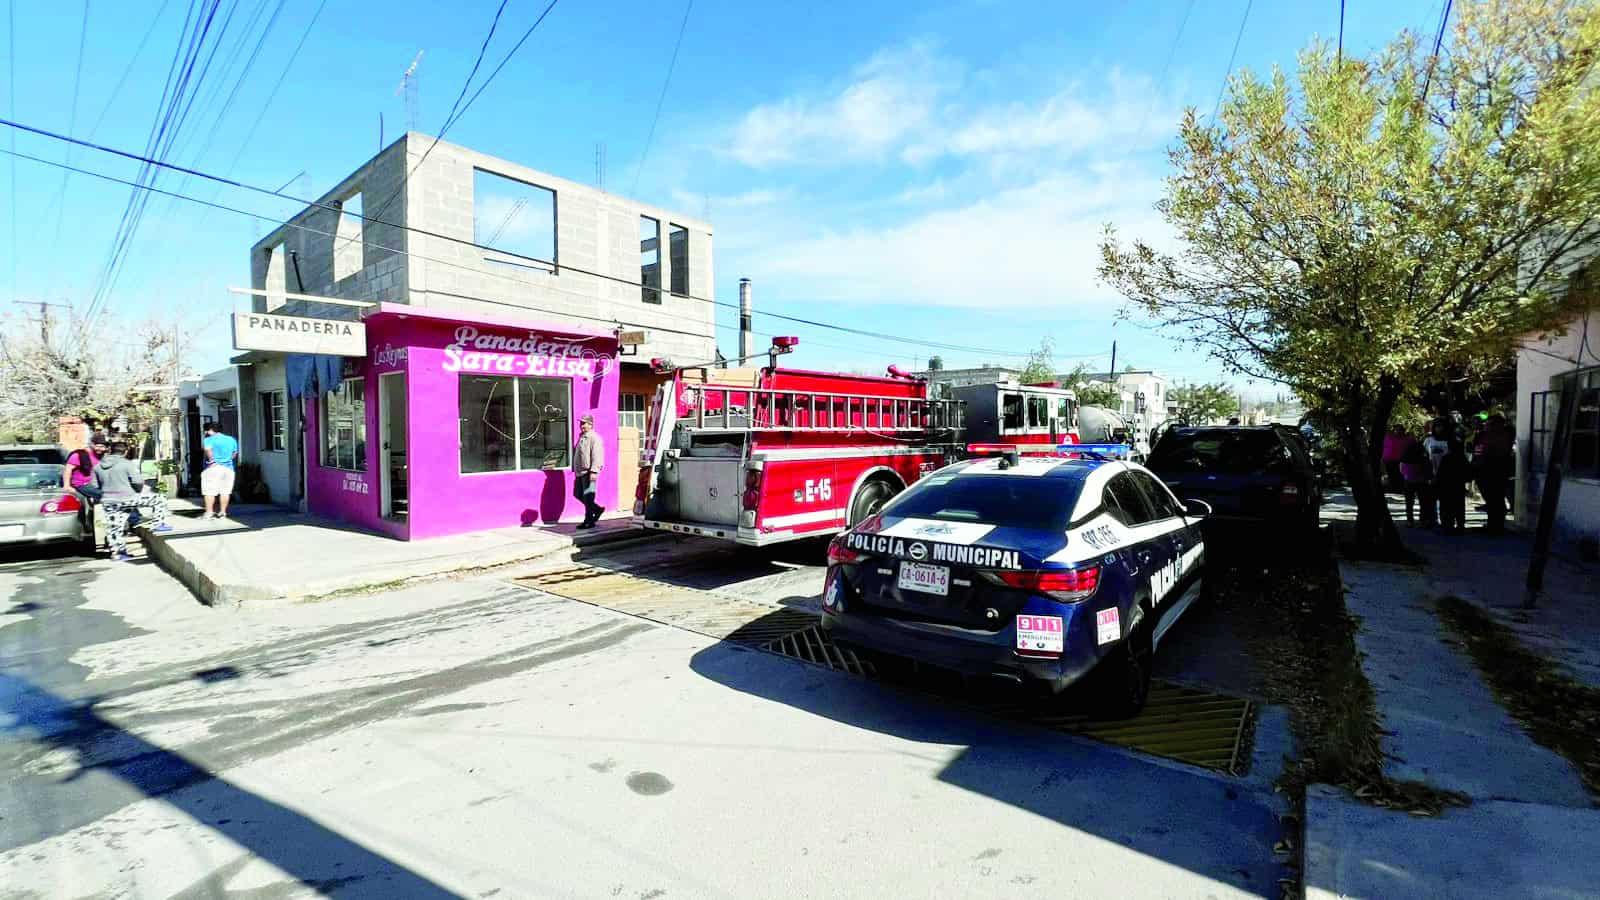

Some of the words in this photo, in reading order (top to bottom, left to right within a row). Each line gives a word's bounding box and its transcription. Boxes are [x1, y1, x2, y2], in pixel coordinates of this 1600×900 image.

[249, 316, 353, 336] PANADERIA
[441, 343, 592, 378] Sara-Elisa
[805, 478, 832, 503] E-15
[847, 533, 905, 557] POLICÍA
[933, 543, 1022, 570] MUNICIPAL
[1019, 616, 1061, 632] 911
